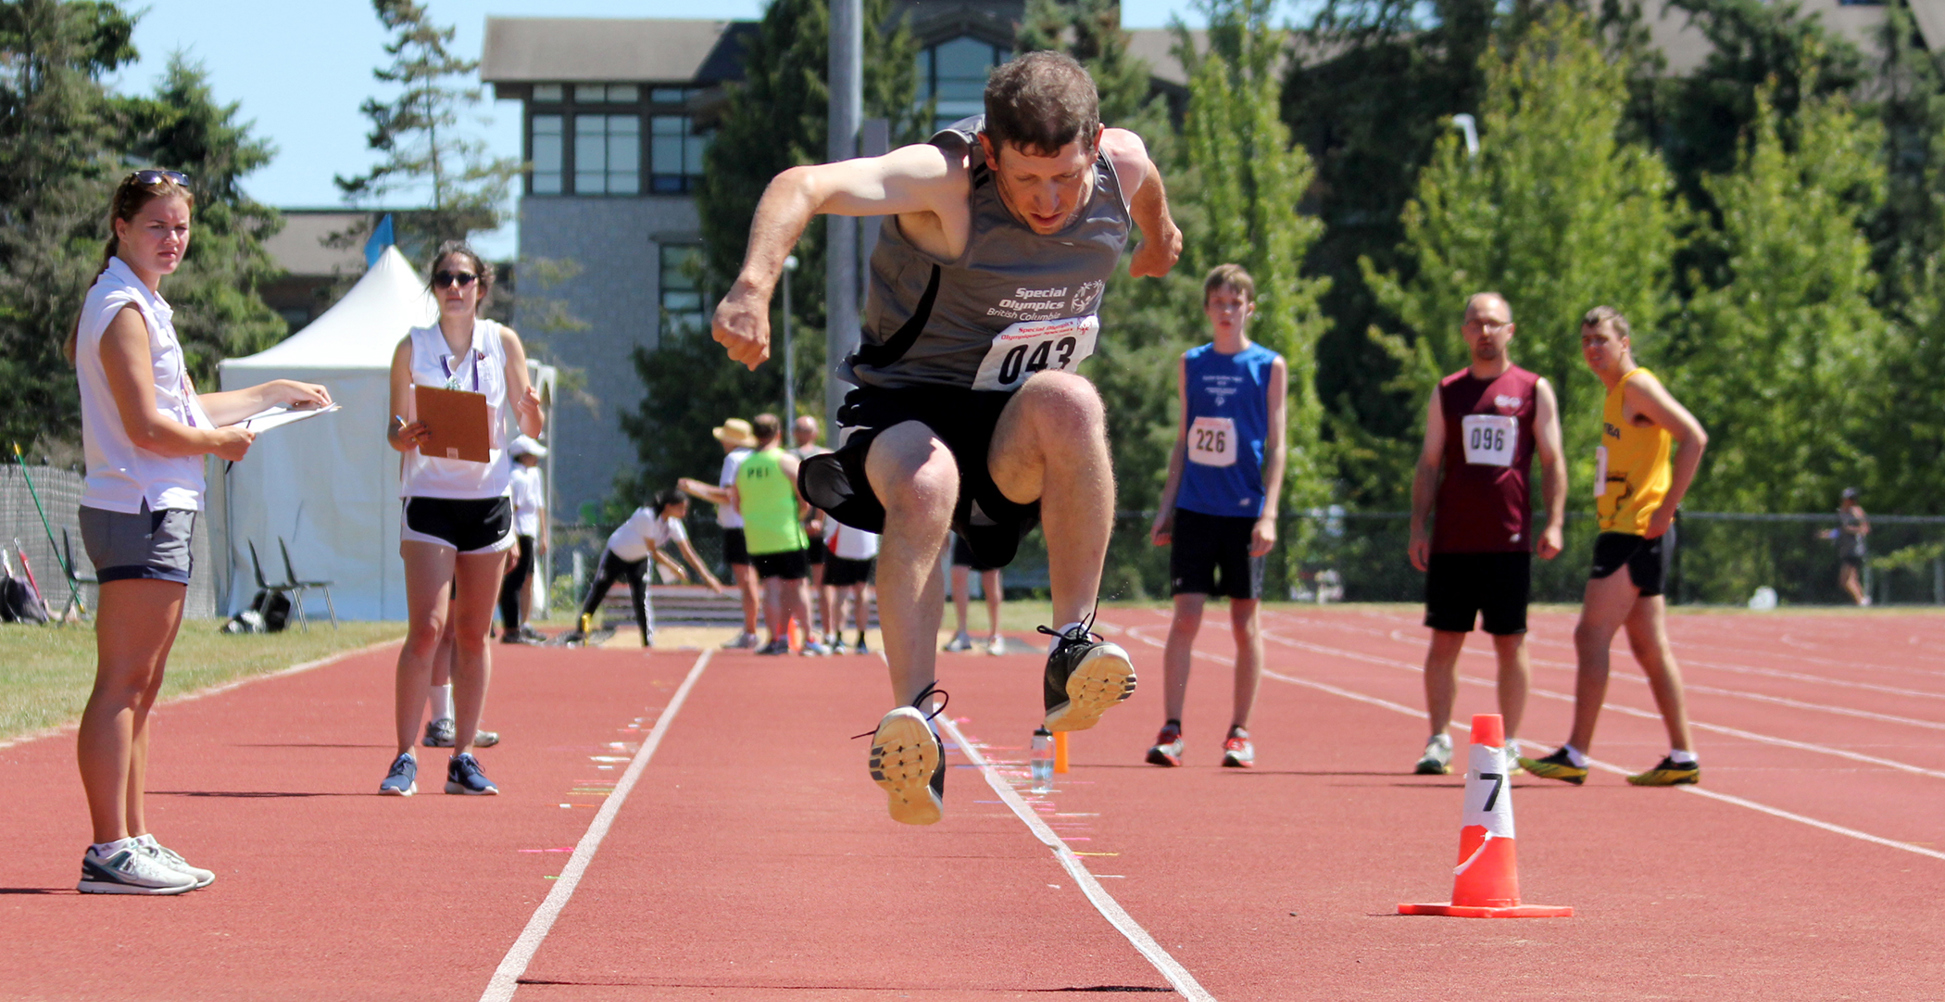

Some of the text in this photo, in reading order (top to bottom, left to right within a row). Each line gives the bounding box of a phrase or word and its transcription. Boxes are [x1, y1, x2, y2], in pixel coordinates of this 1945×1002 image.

[1015, 287, 1068, 299] Special
[986, 308, 1017, 318] British
[999, 299, 1065, 311] Olympics
[998, 336, 1076, 385] 043
[1196, 428, 1225, 453] 226
[1471, 428, 1505, 451] 096
[747, 467, 769, 478] PEI
[1479, 773, 1503, 812] 7
